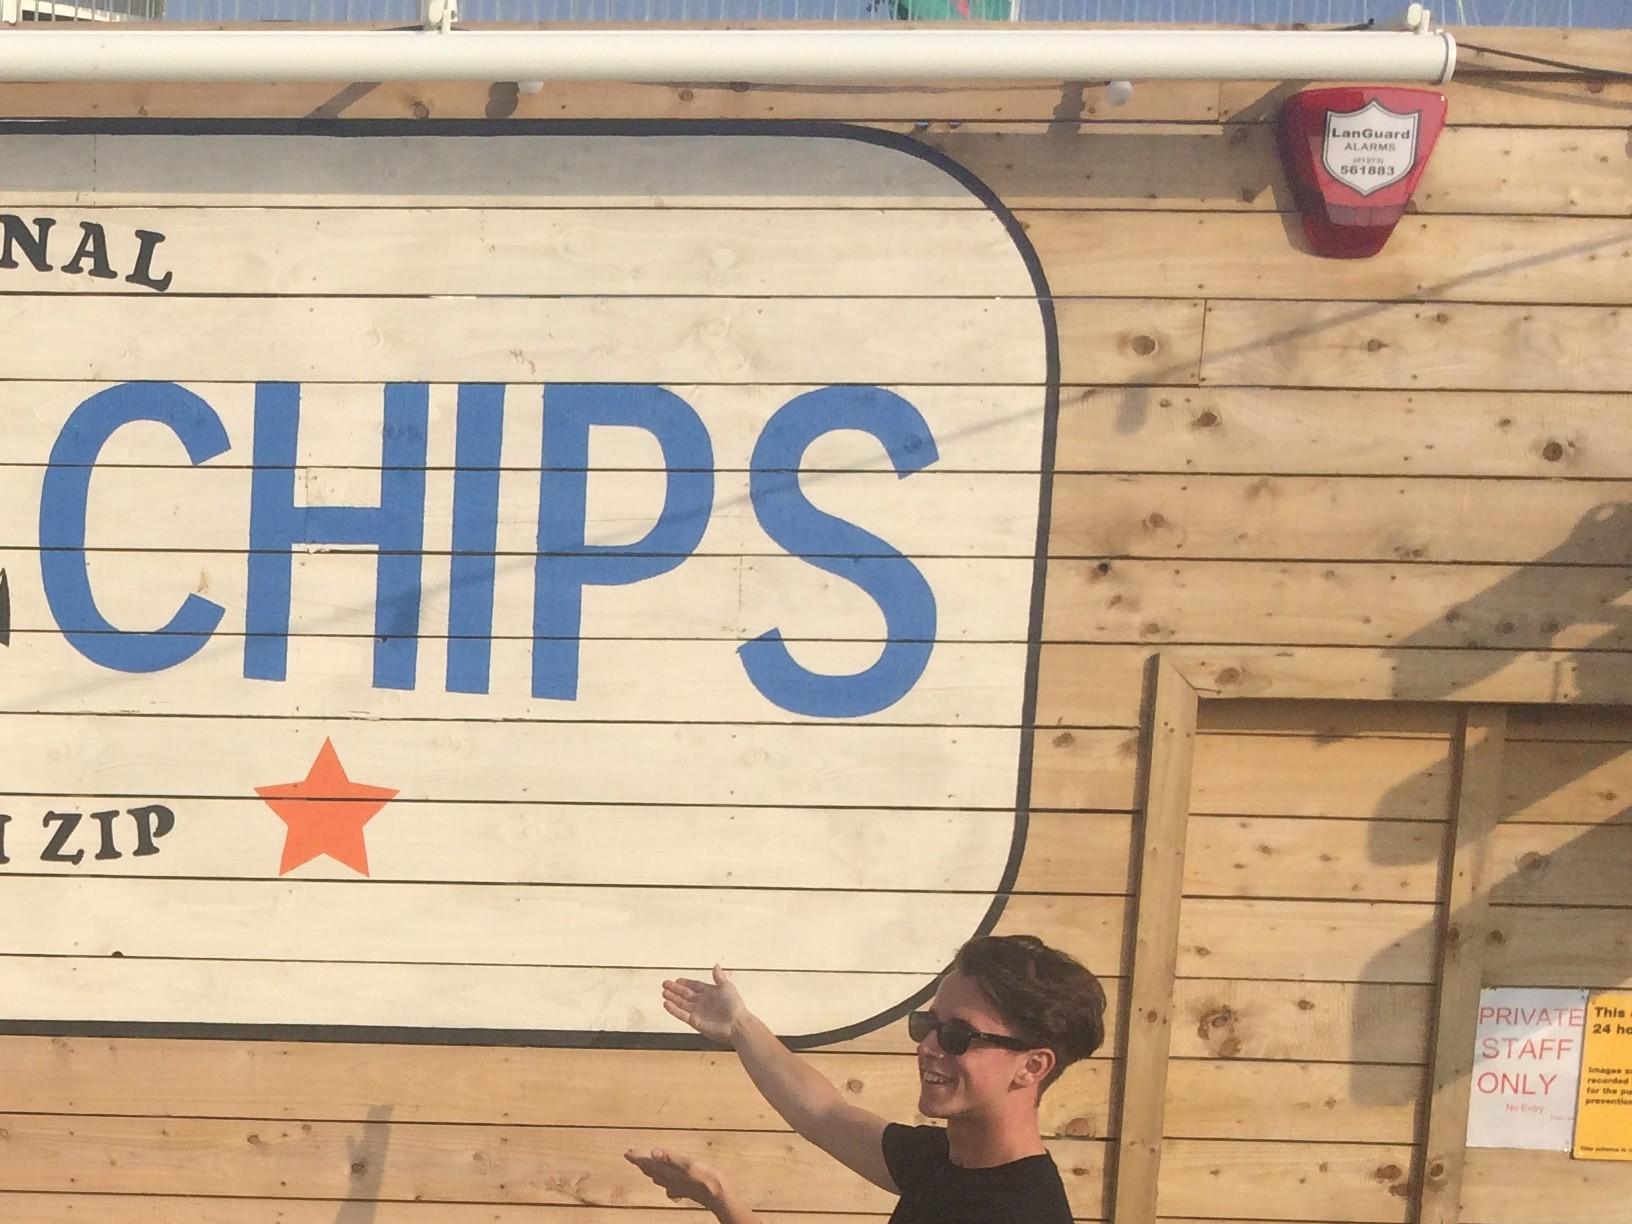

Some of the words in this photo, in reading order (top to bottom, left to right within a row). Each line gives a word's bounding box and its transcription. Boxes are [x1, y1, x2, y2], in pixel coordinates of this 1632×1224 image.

[1331, 127, 1411, 140] LanGuard
[1344, 142, 1396, 152] ALARMS
[1340, 165, 1395, 176] 561883
[38, 379, 941, 718] CHIPS
[39, 804, 175, 866] ZIP
[1479, 1006, 1584, 1027] PRIVATE
[1594, 1006, 1625, 1018] This
[1592, 1023, 1611, 1034] 24
[1481, 1037, 1574, 1060] STAFF
[1477, 1071, 1558, 1095] ONLY
[1586, 1087, 1599, 1095] for
[1602, 1087, 1617, 1095] the
[1521, 1103, 1545, 1116] Entry
